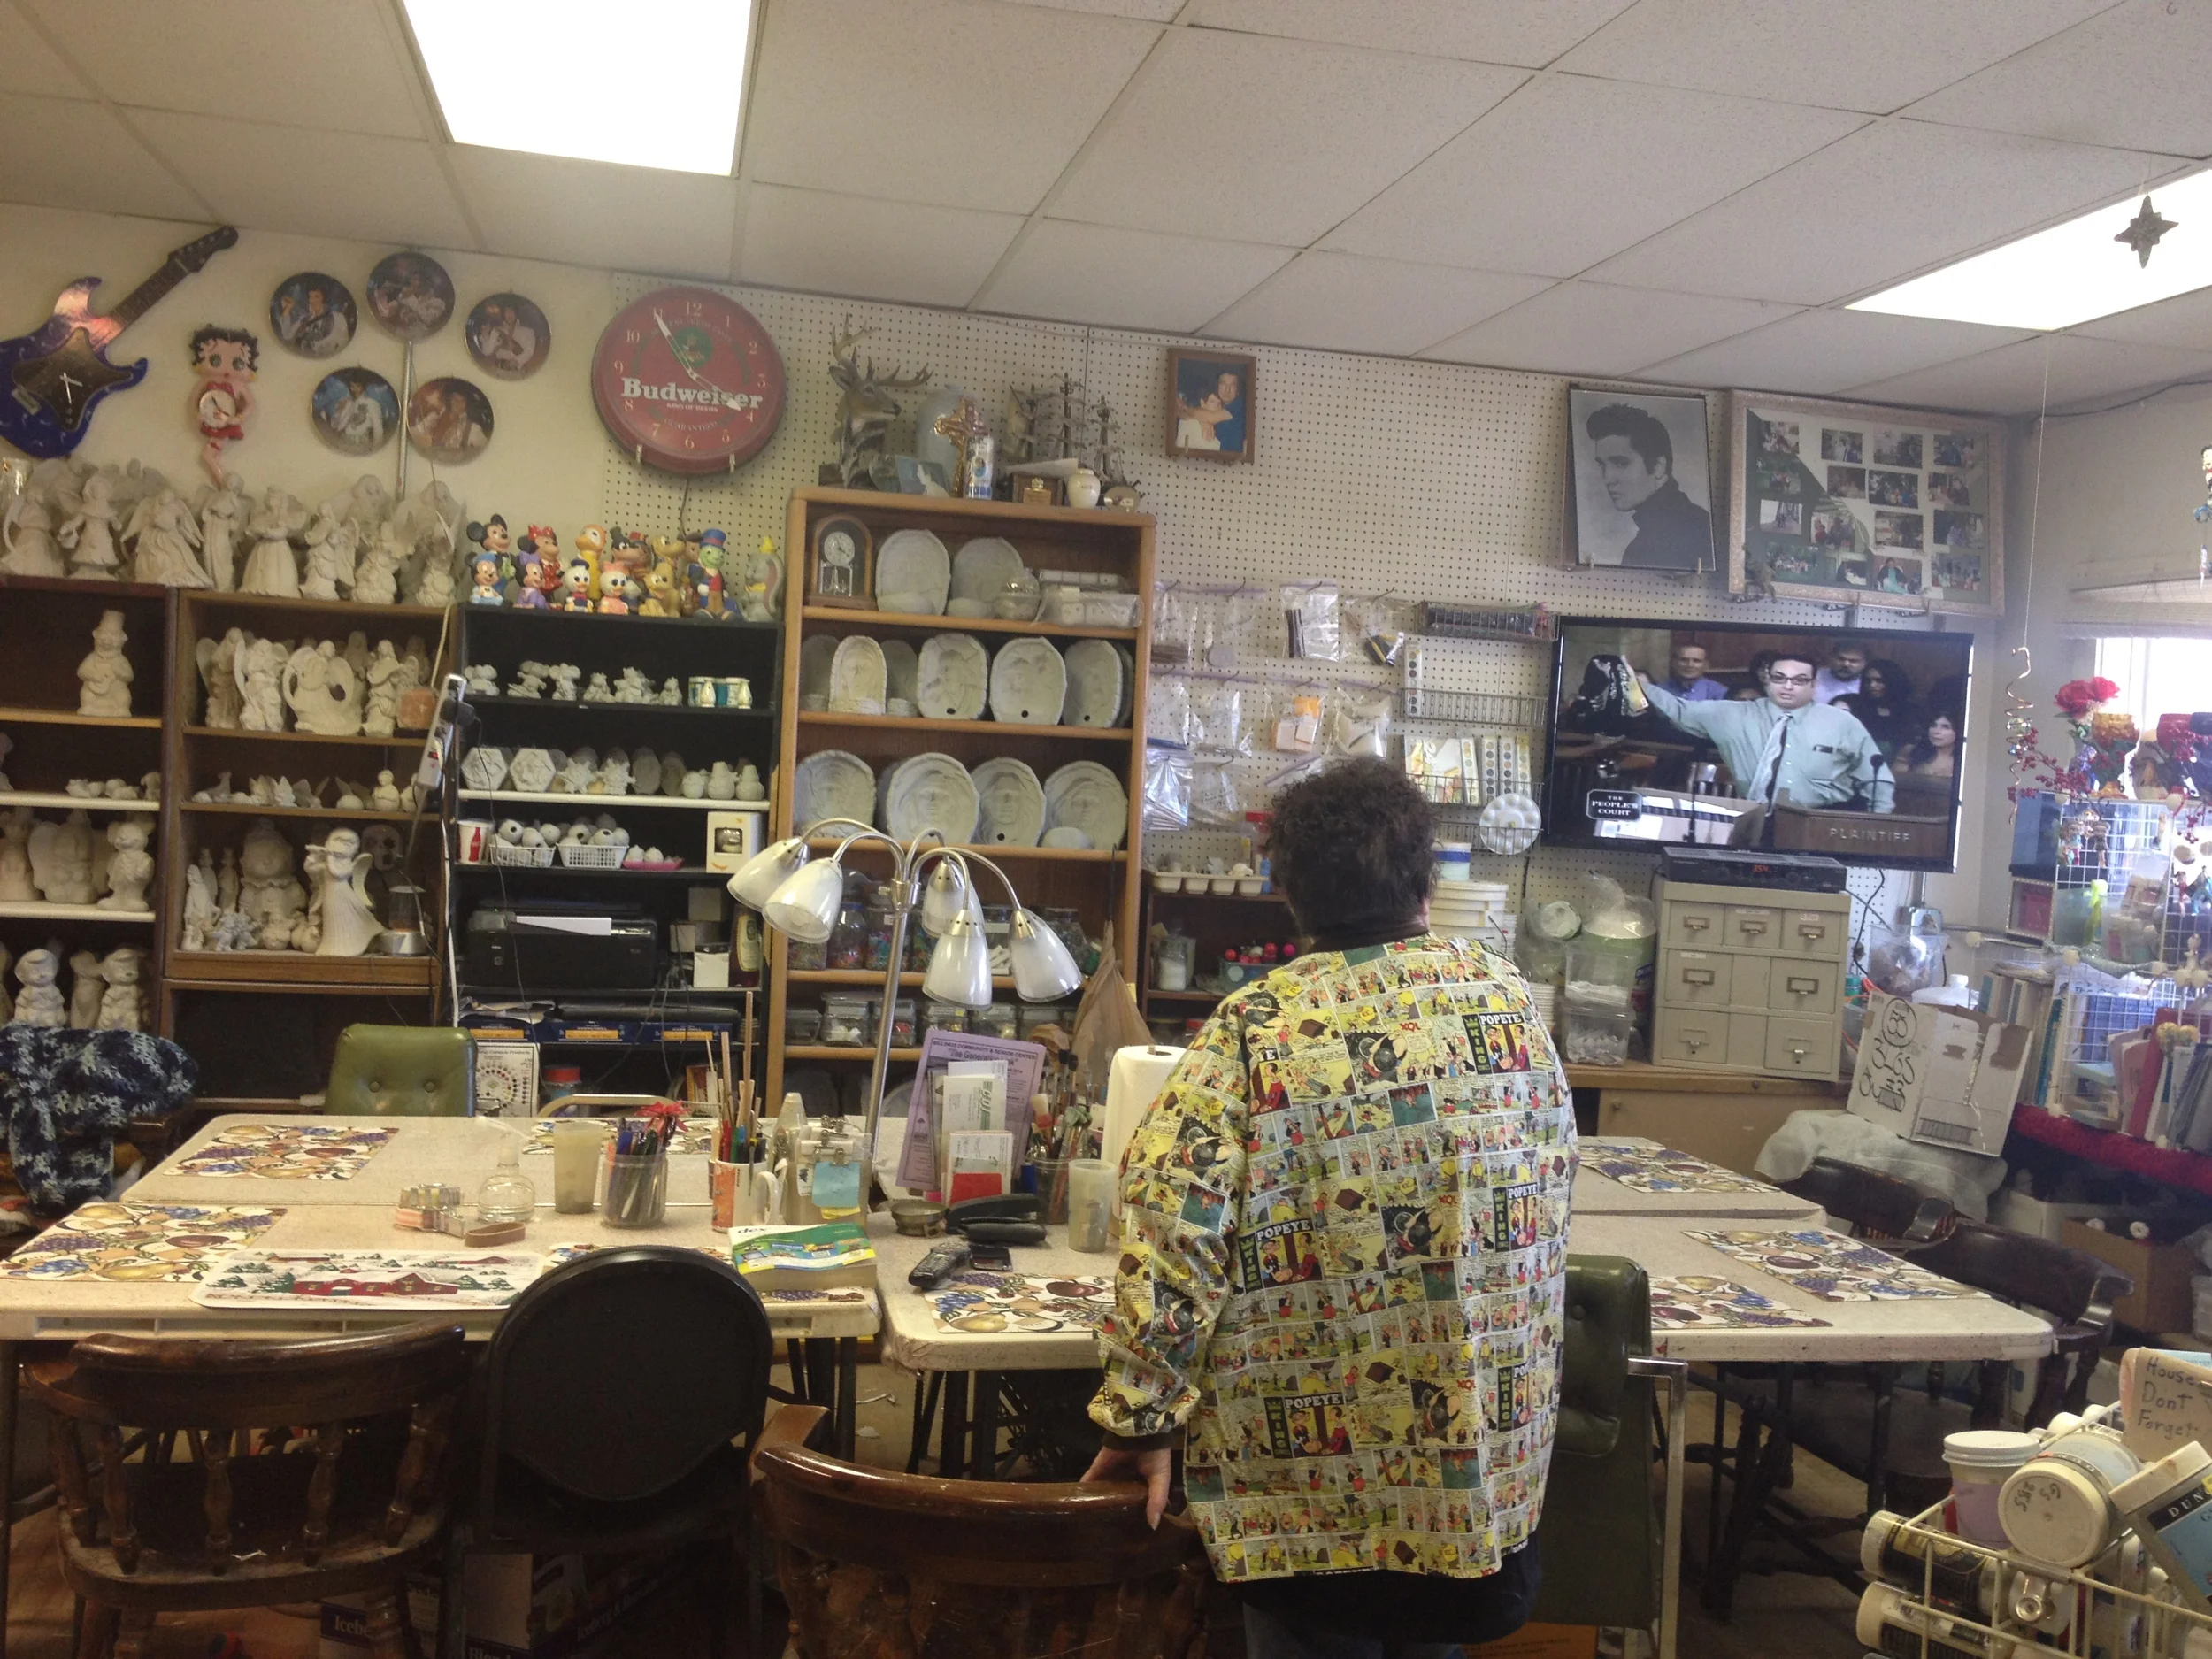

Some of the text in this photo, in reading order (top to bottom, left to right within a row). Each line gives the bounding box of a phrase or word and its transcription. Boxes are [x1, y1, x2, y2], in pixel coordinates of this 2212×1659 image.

[686, 302, 702, 318] 12
[626, 330, 640, 343] 10
[749, 342, 757, 355] 2
[614, 361, 624, 373] 9
[621, 378, 764, 410] Budweiser
[625, 399, 634, 411] 8
[652, 424, 661, 437] 7
[685, 435, 695, 449] 6
[1592, 800, 1639, 809] PEOPLE'S
[1829, 827, 1911, 841] PLAINTIFF
[1479, 1013, 1523, 1025] POPEYE
[1470, 1028, 1488, 1064] KING
[1496, 1203, 1507, 1240] KING
[1256, 1219, 1310, 1241] POPEYE
[2146, 1356, 2196, 1386] House
[1284, 1394, 1340, 1409] POPEYE
[2168, 1492, 2205, 1518] DUN
[334, 1613, 371, 1637] Icebe
